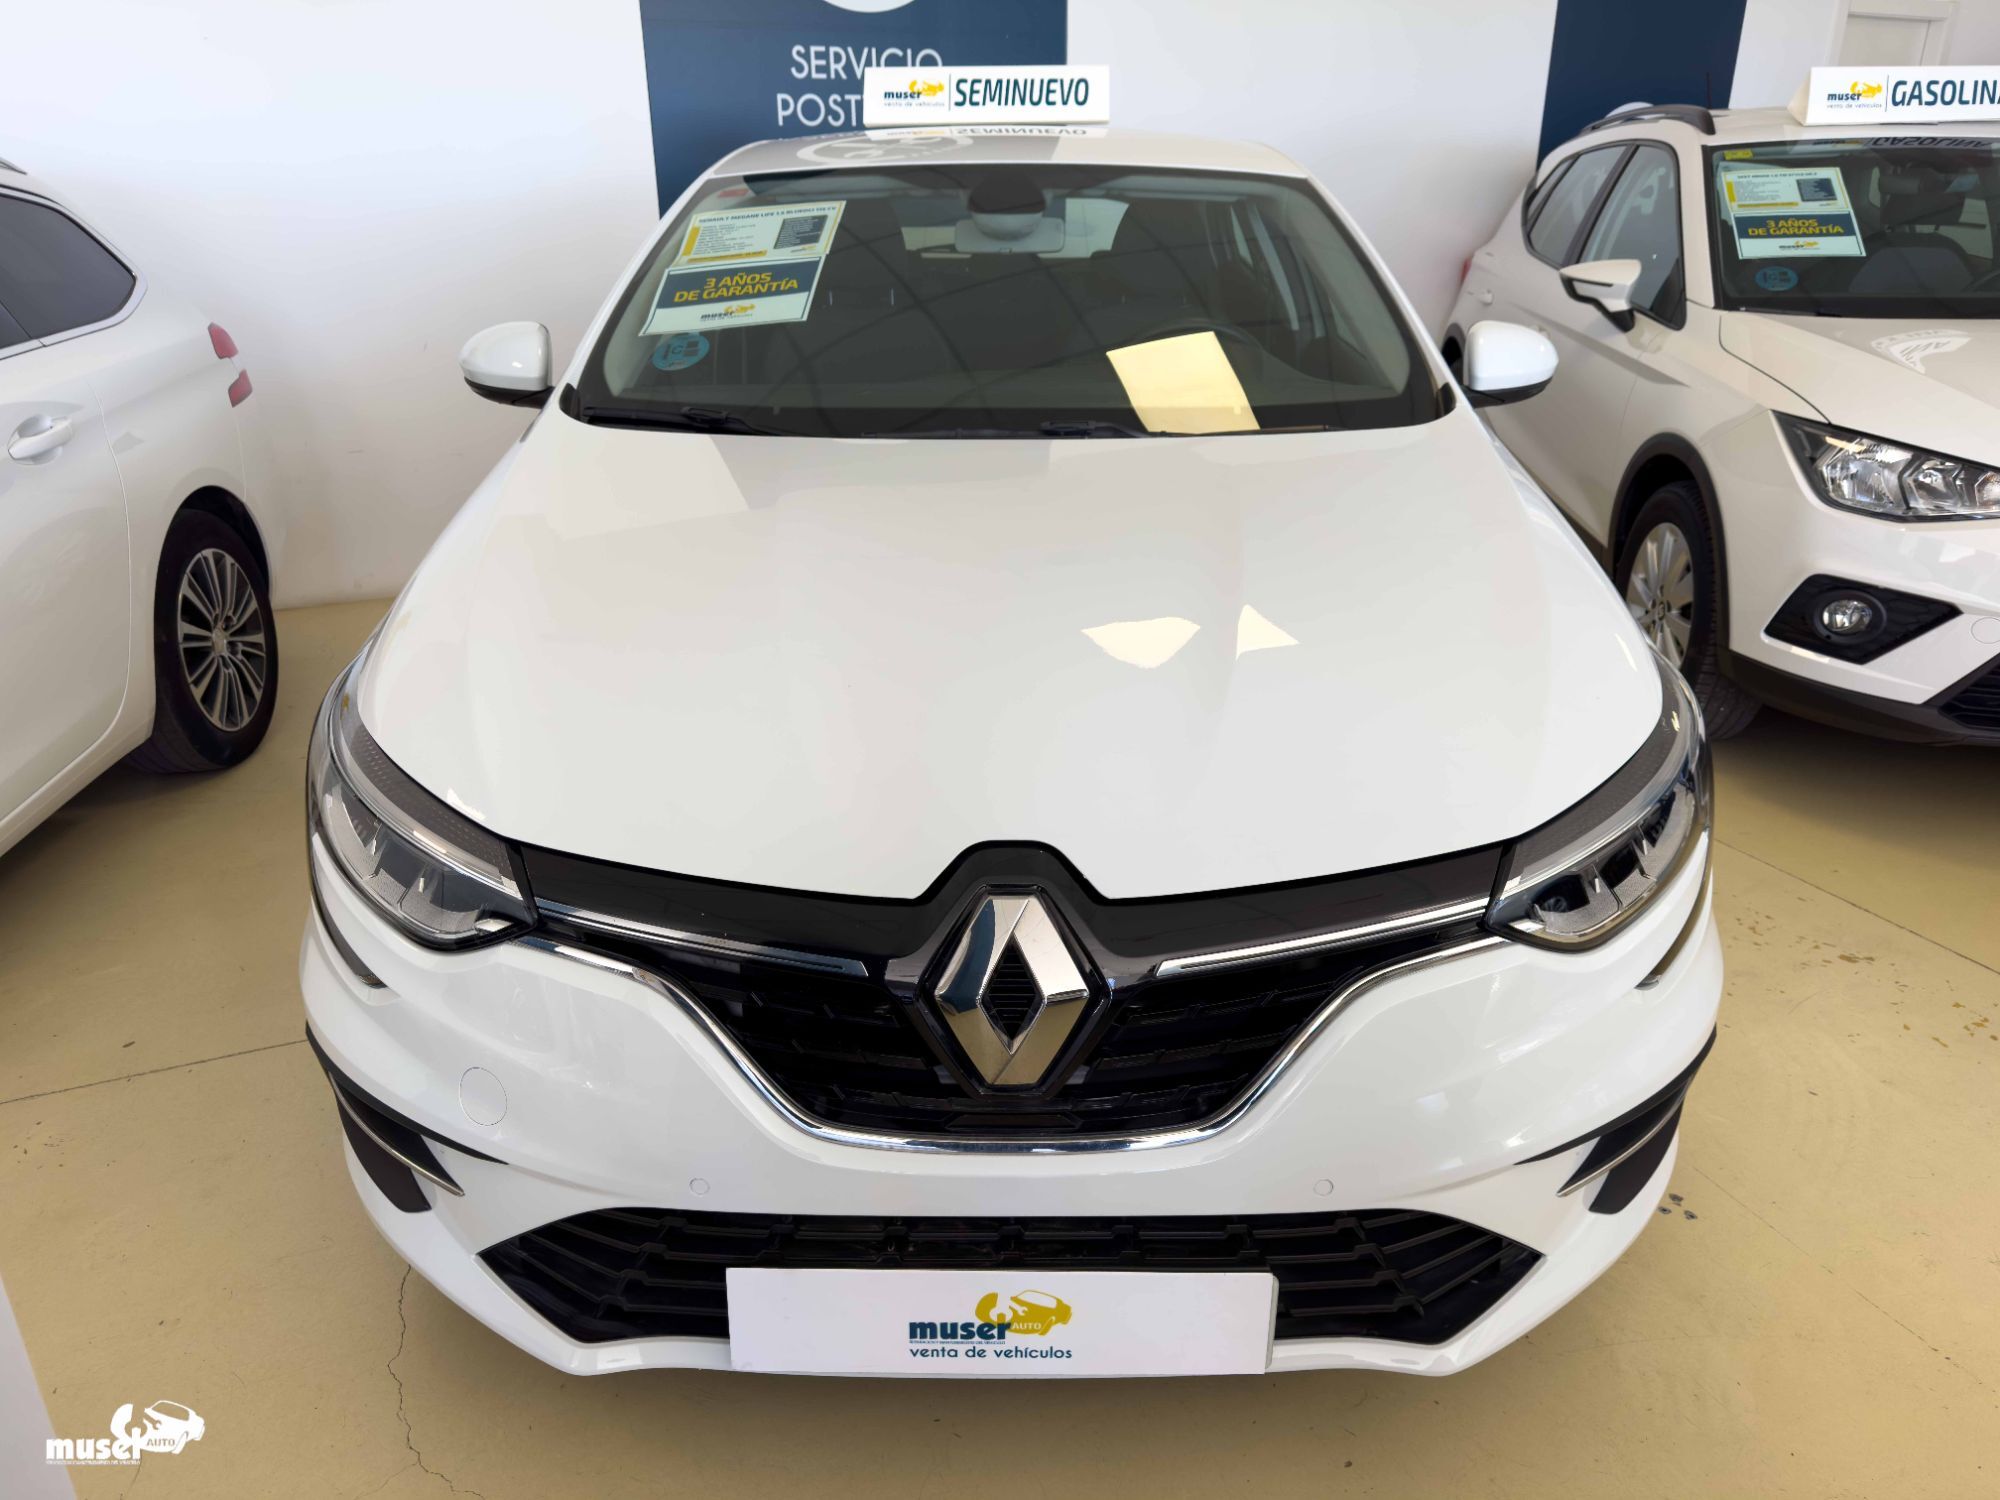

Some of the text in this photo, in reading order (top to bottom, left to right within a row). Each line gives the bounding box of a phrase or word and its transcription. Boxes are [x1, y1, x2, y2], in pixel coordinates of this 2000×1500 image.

[884, 90, 922, 99] muser
[954, 78, 1090, 107] SEMINUEVO
[1827, 93, 1862, 101] muser
[1891, 80, 2000, 107] GASOLIN
[776, 93, 864, 127] POST
[1766, 218, 1818, 228] 3 AÑOS
[1769, 224, 1844, 235] GARANTÍA
[704, 272, 771, 288] 3 AÑOS
[674, 278, 798, 302] DE GARANTÍA
[909, 1321, 1042, 1340] muser AUTO
[909, 1346, 1072, 1359] venta de vehículos
